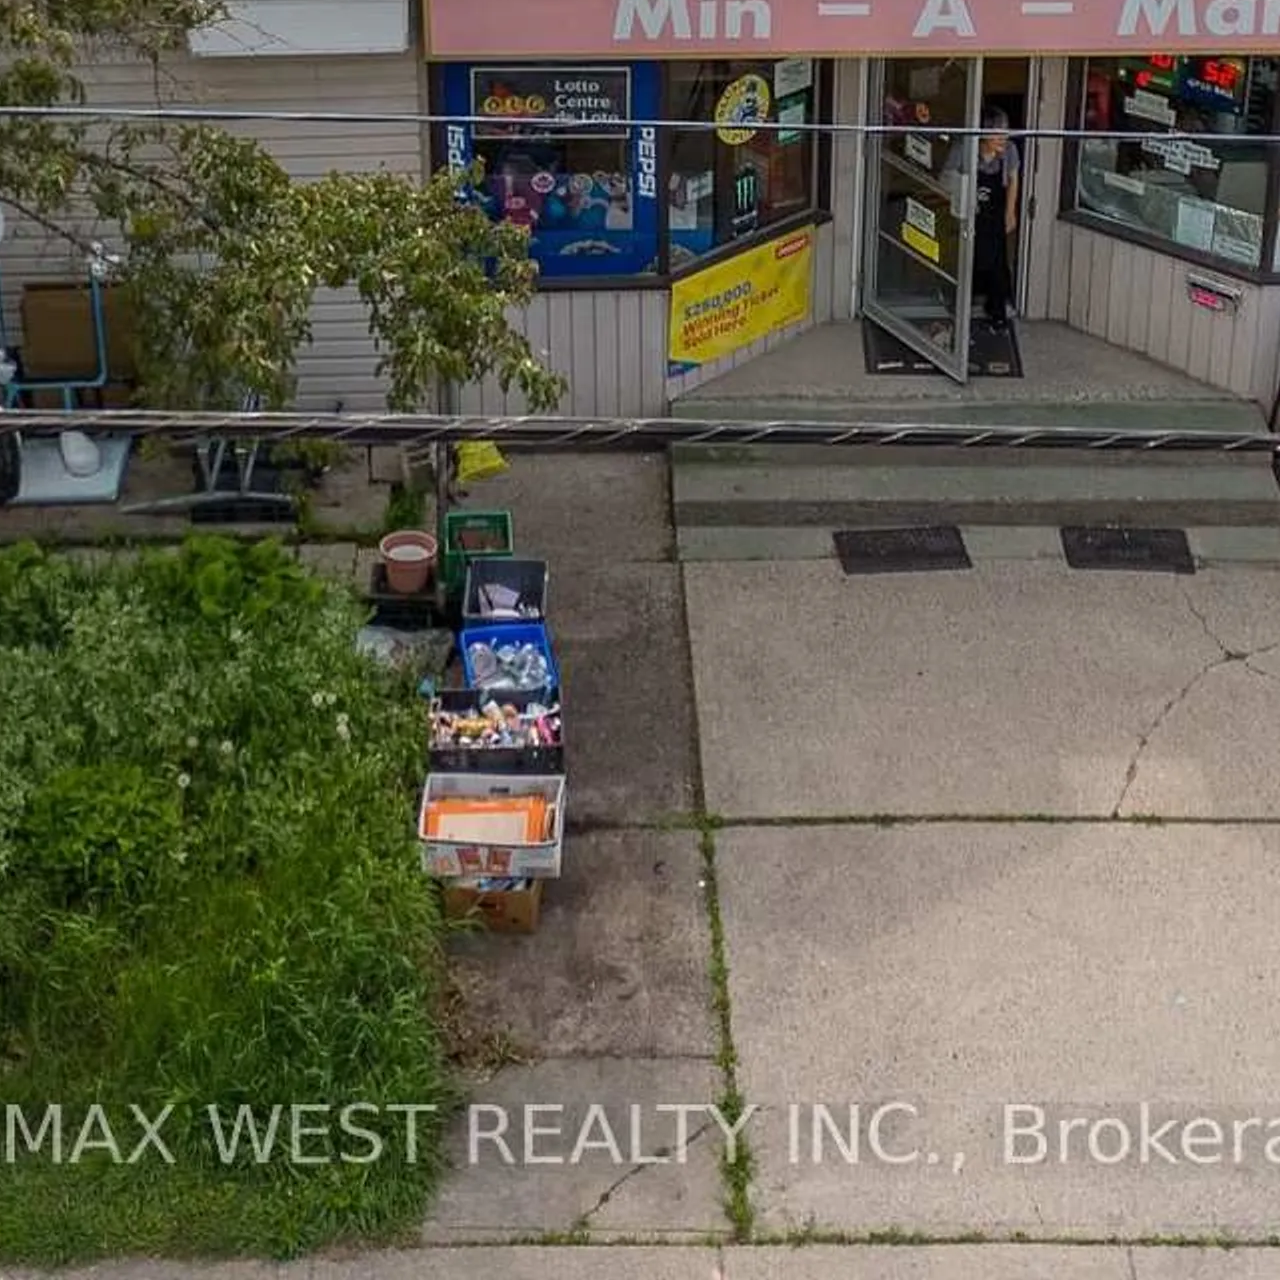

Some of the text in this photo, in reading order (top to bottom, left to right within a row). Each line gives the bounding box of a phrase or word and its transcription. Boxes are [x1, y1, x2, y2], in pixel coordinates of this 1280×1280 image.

[554, 79, 600, 93] Lotto
[554, 95, 612, 109] Centre
[638, 126, 657, 199] PEPSI
